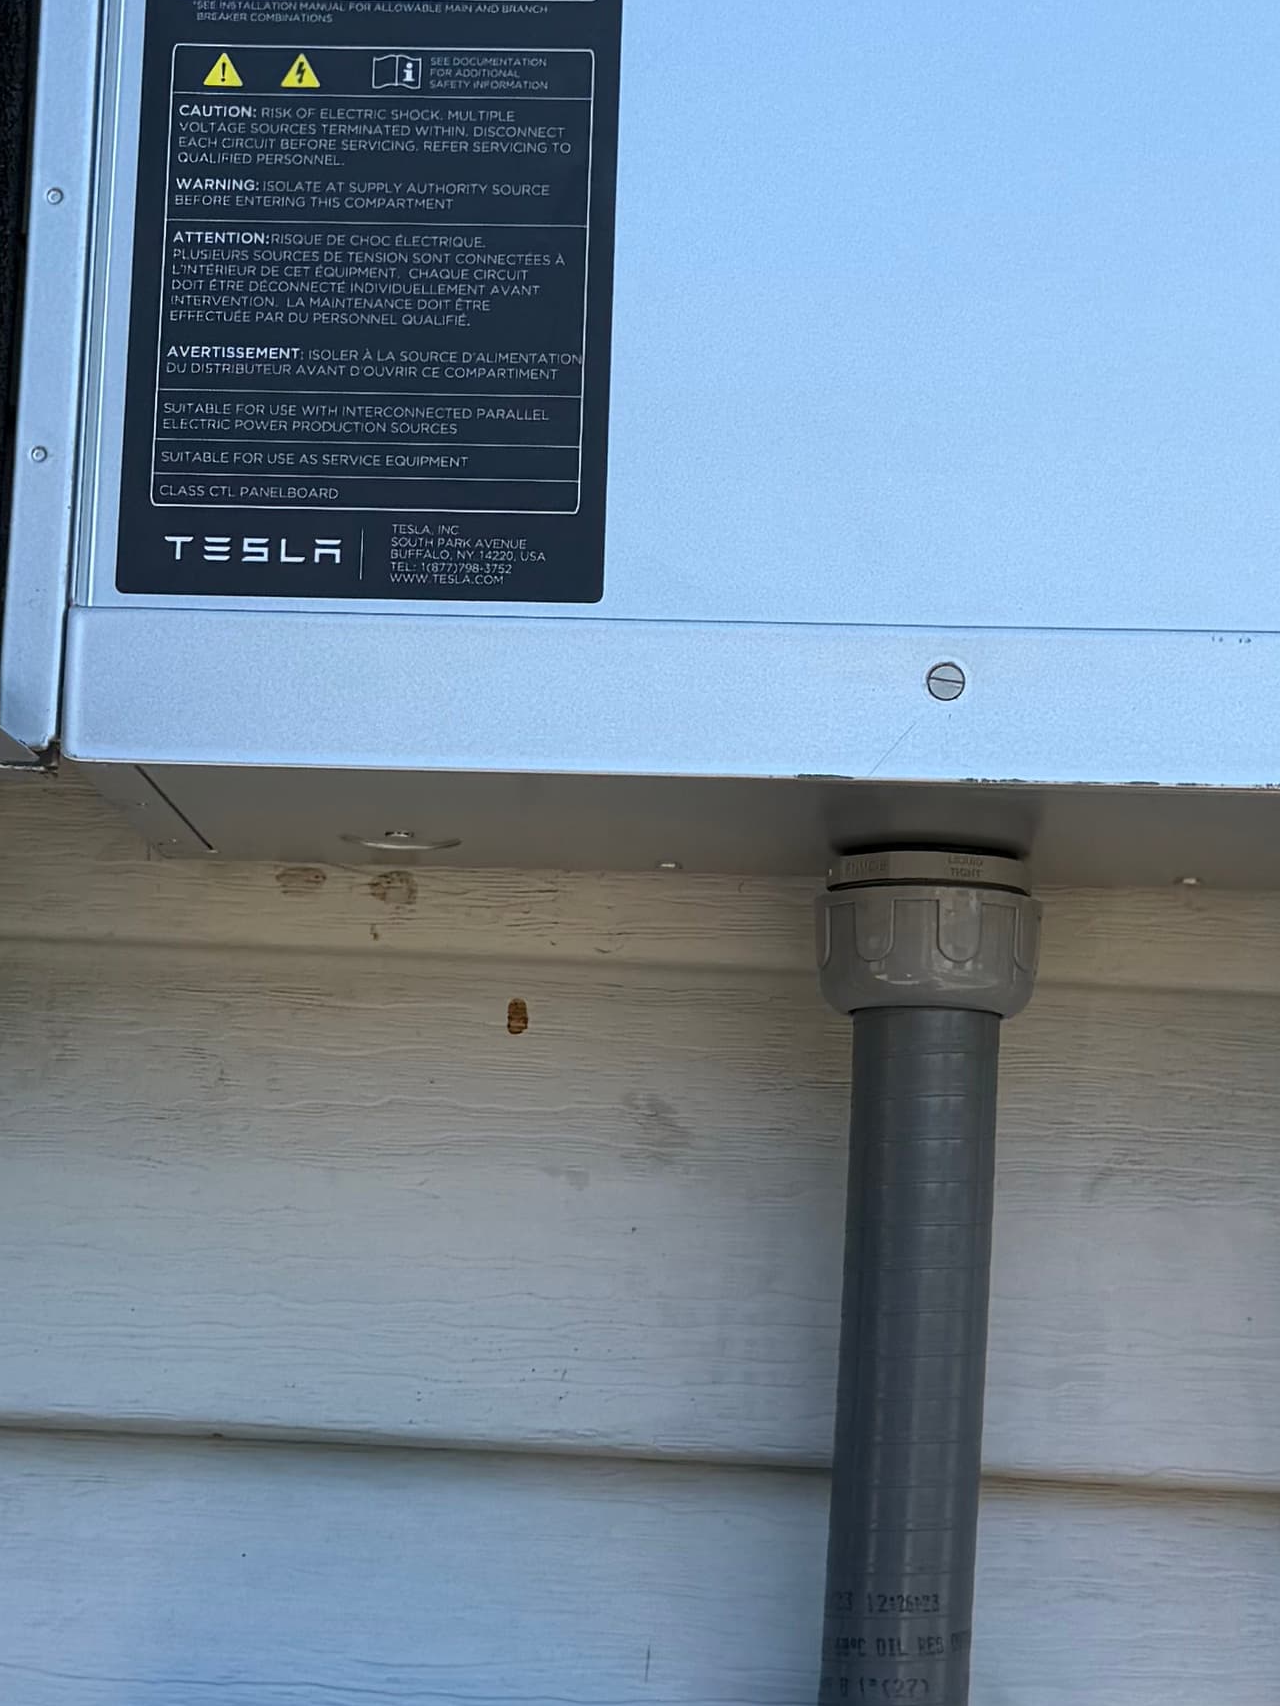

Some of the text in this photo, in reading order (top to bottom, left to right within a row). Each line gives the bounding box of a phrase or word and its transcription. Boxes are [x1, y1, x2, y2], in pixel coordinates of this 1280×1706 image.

[179, 104, 515, 122] CAUTION: RISK OF ELECTRIC SHOCK. MULTIPLE
[179, 121, 565, 138] VOLTAGE SOURCES TERMINATED WITHIN. DISCONNECT
[179, 136, 571, 154] EACH CIRCUIT BEFORE SERVICING. REFER SERVICING TO
[177, 151, 344, 166] QUALIFIED PERSONNEL.
[176, 177, 549, 196] WARNING: ISOLATE AT SUPPLY AUTHORITY SOURCE
[175, 194, 454, 210] BEFORE ENTERING THIS COMPARTMENT
[163, 402, 549, 421] SUITABLE FOR USE WITH INTERCONNECTED PARALLEL
[163, 418, 458, 435] ELECTRIC POWER PRODUCTION SOURCES
[159, 484, 339, 499] CLASS CTL PANELBOARD
[164, 536, 341, 563] TESLA
